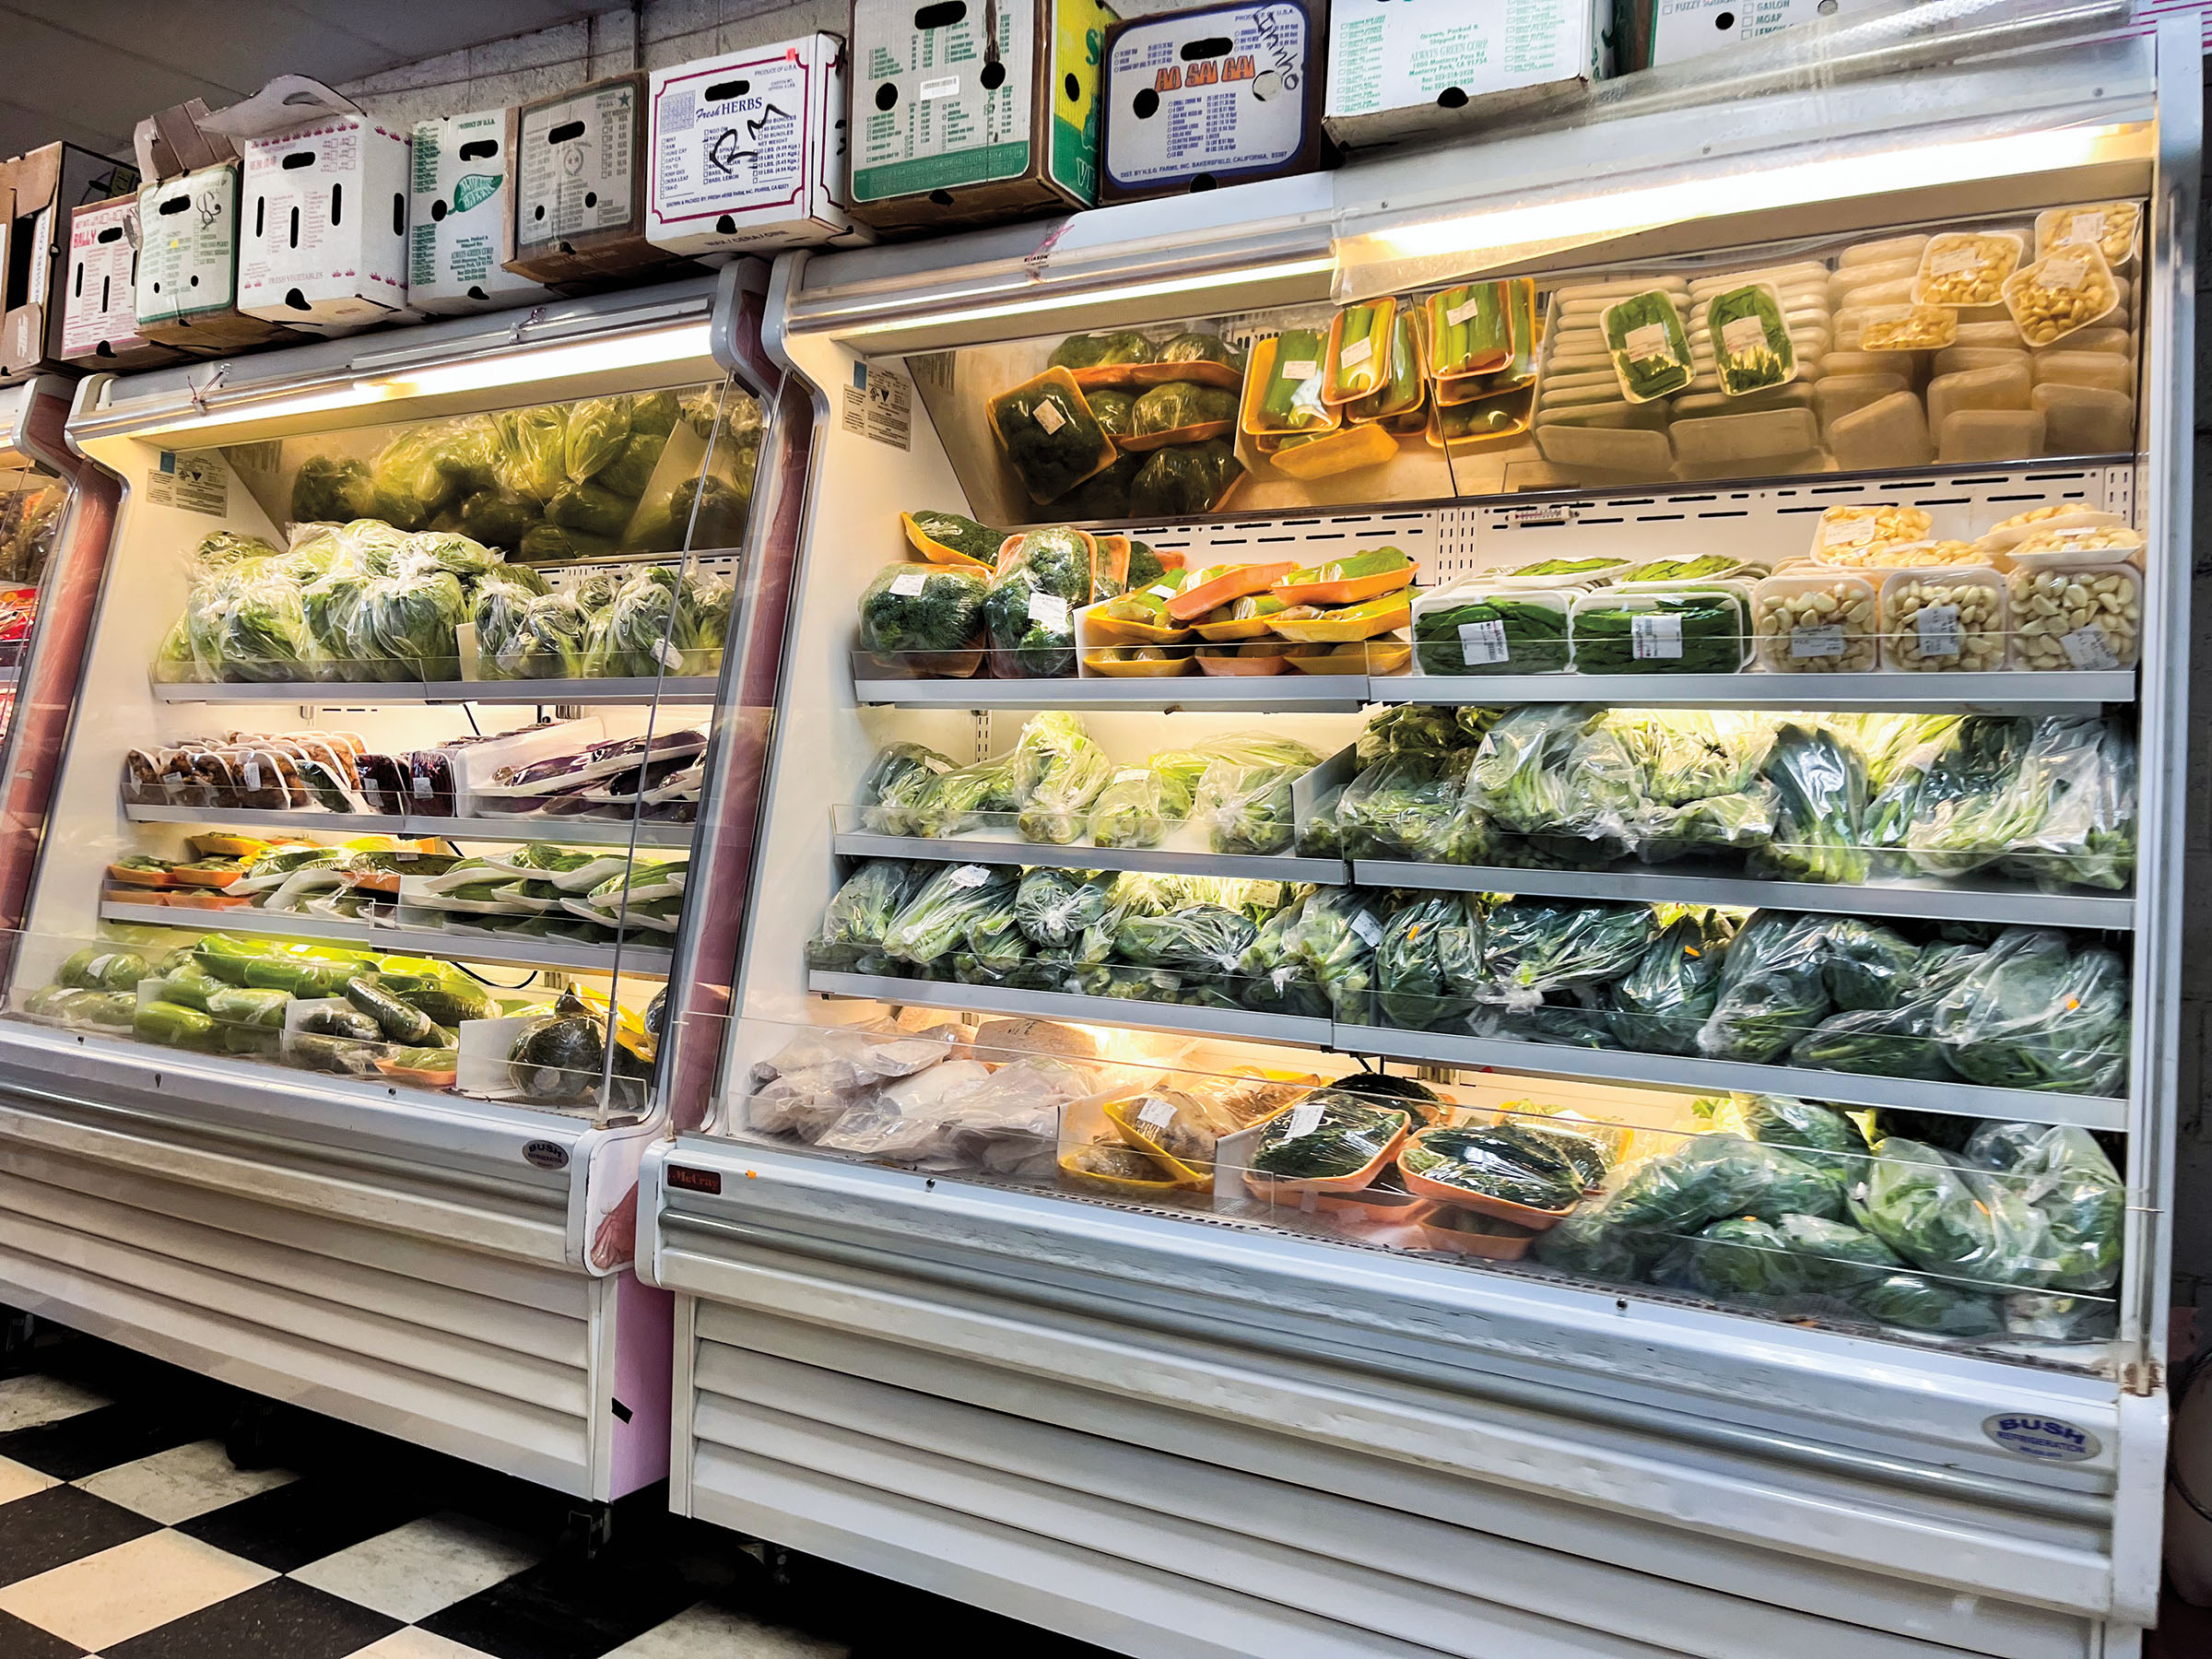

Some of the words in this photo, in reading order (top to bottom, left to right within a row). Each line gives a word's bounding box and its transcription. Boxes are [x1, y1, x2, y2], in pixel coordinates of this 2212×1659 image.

[1675, 1, 1700, 12] FUZZY
[696, 106, 722, 122] Fresh
[722, 97, 763, 115] HERBS
[771, 122, 794, 132] BUNDLES
[771, 129, 794, 138] BUNDLES
[723, 174, 740, 182] LEMON
[528, 1142, 563, 1159] BUSH
[527, 1152, 563, 1166] REFRIGERATION
[1998, 1418, 2086, 1445] BUSH
[1996, 1430, 2087, 1453] REFRIGERATION
